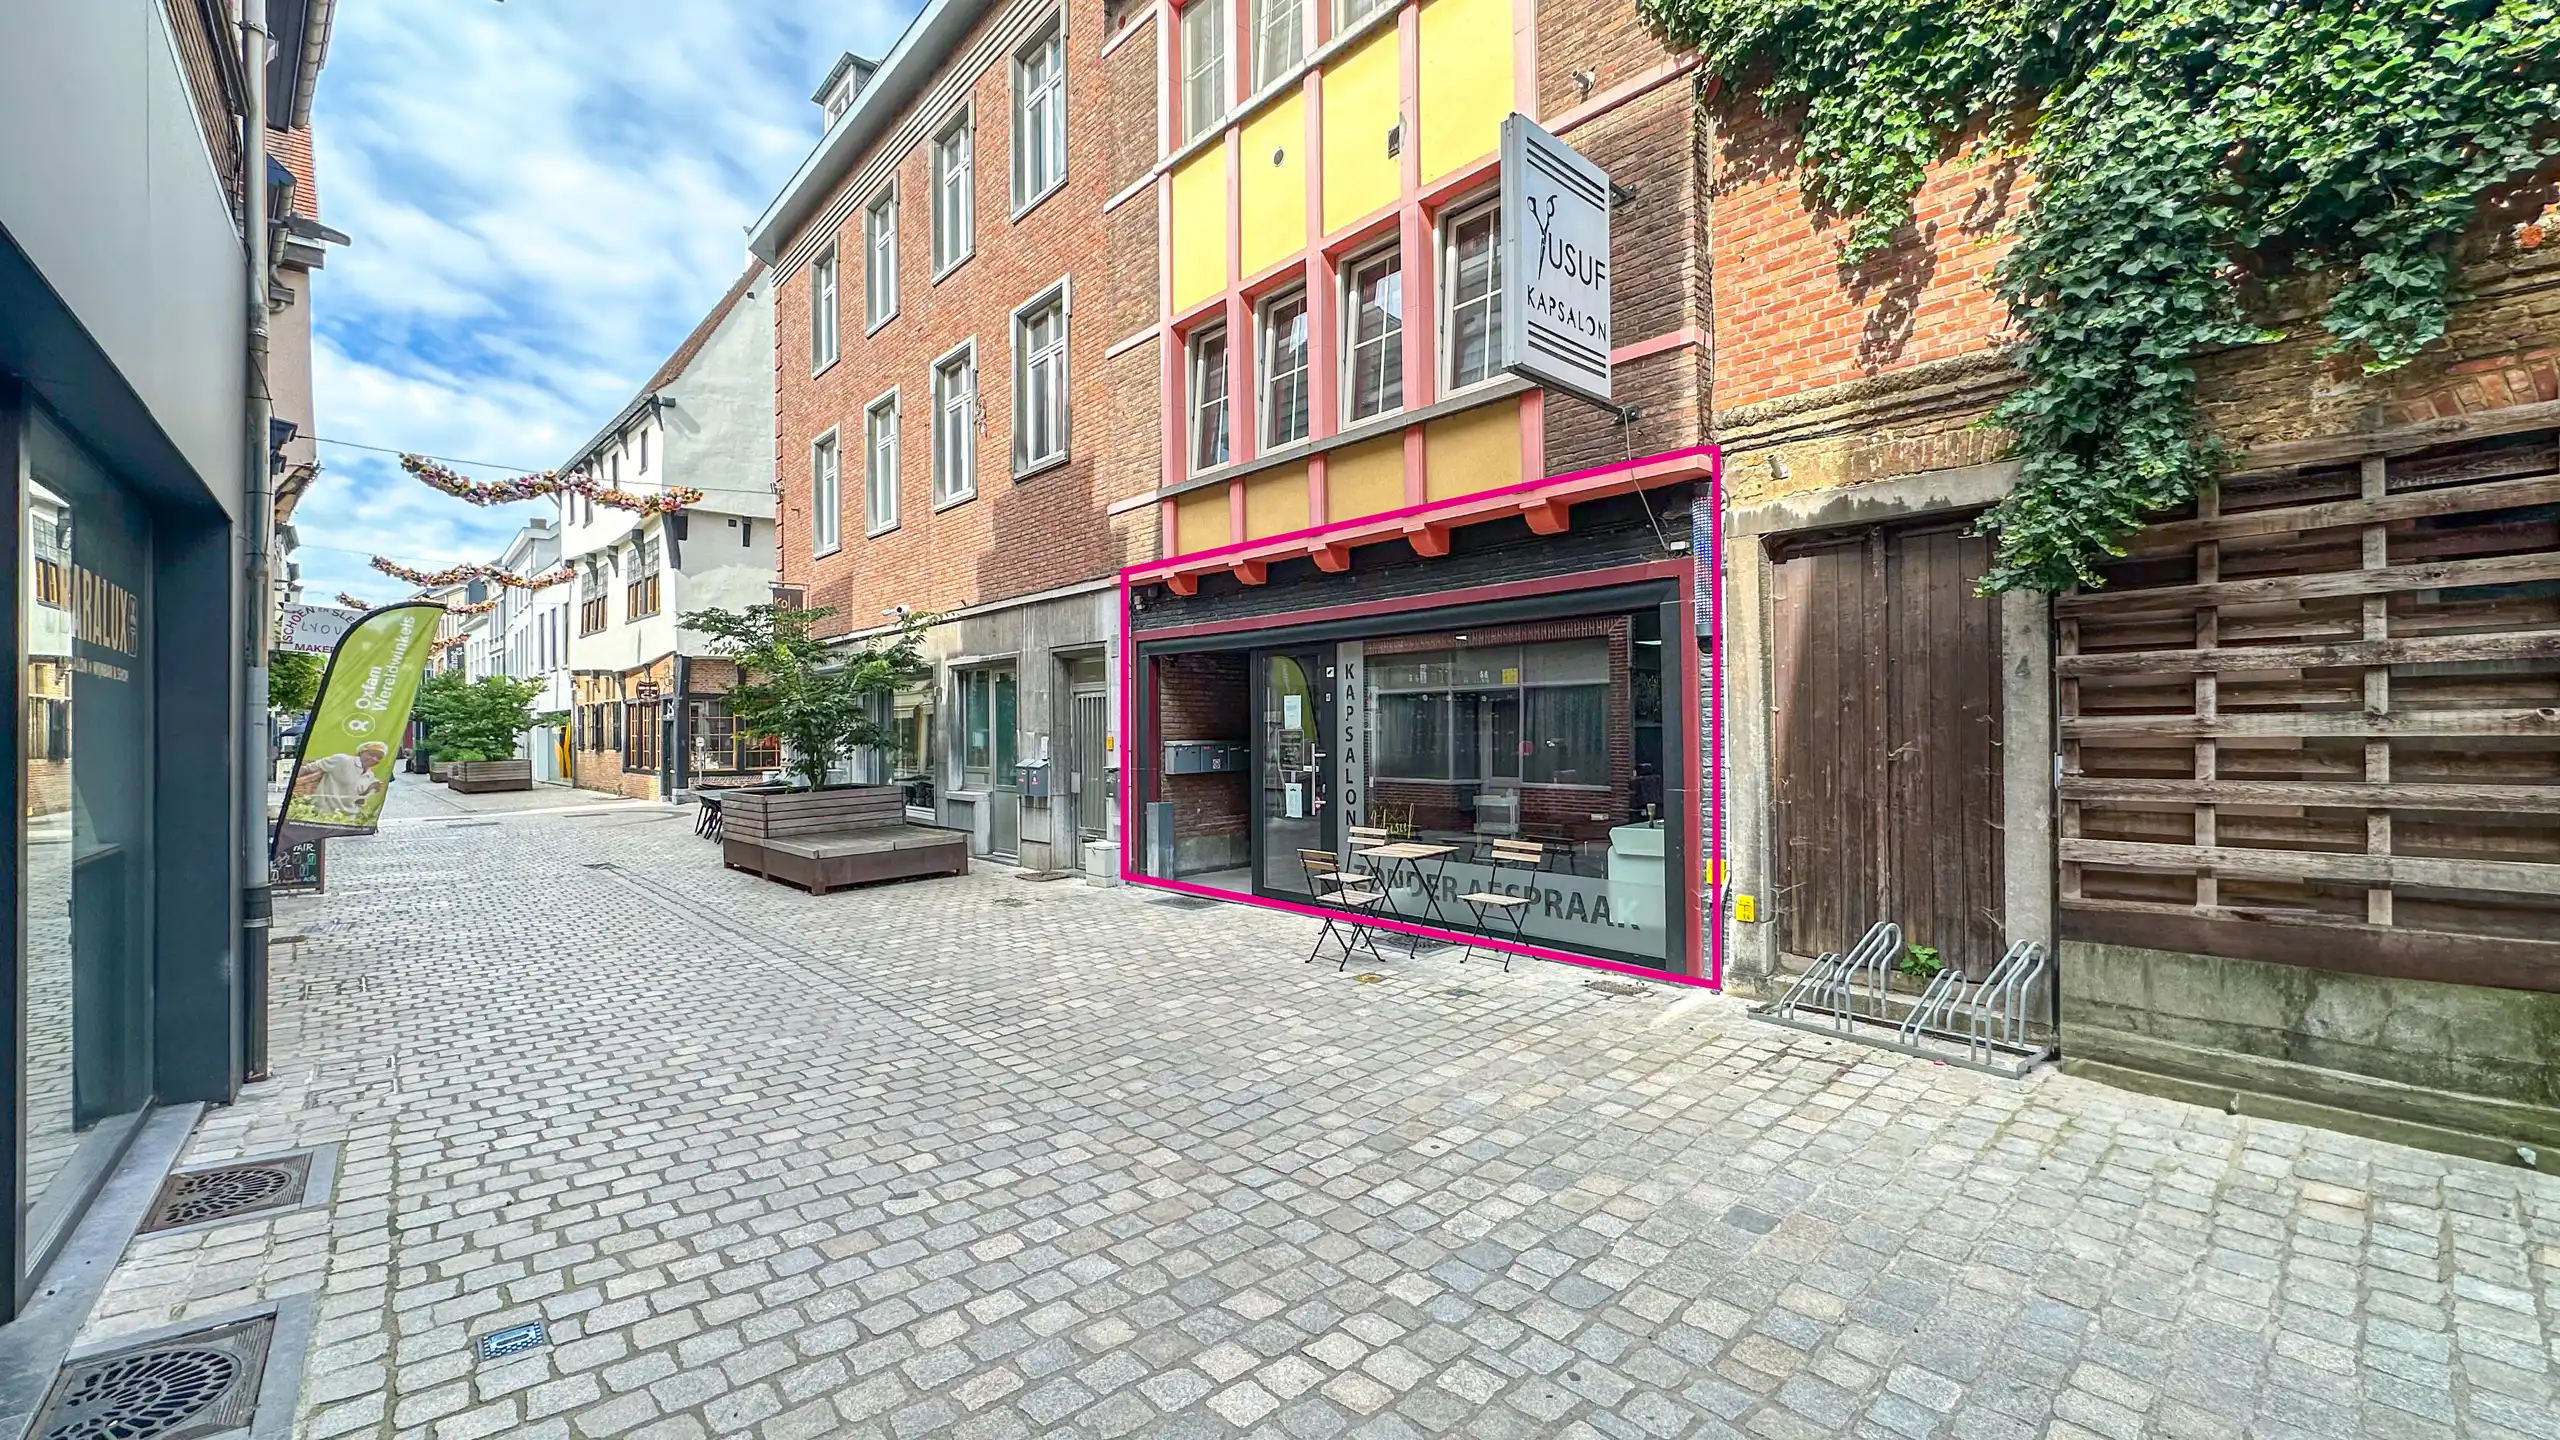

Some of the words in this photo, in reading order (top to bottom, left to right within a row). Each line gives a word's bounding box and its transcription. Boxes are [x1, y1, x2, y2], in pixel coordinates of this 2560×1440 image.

[1527, 284, 1607, 343] KAPSALON
[282, 606, 315, 642] SCHOEN
[355, 666, 382, 709] Oxfam
[371, 617, 416, 711] Wereldwinkels
[1344, 663, 1357, 826] KAPSALON
[1353, 864, 1459, 903] ZONDER
